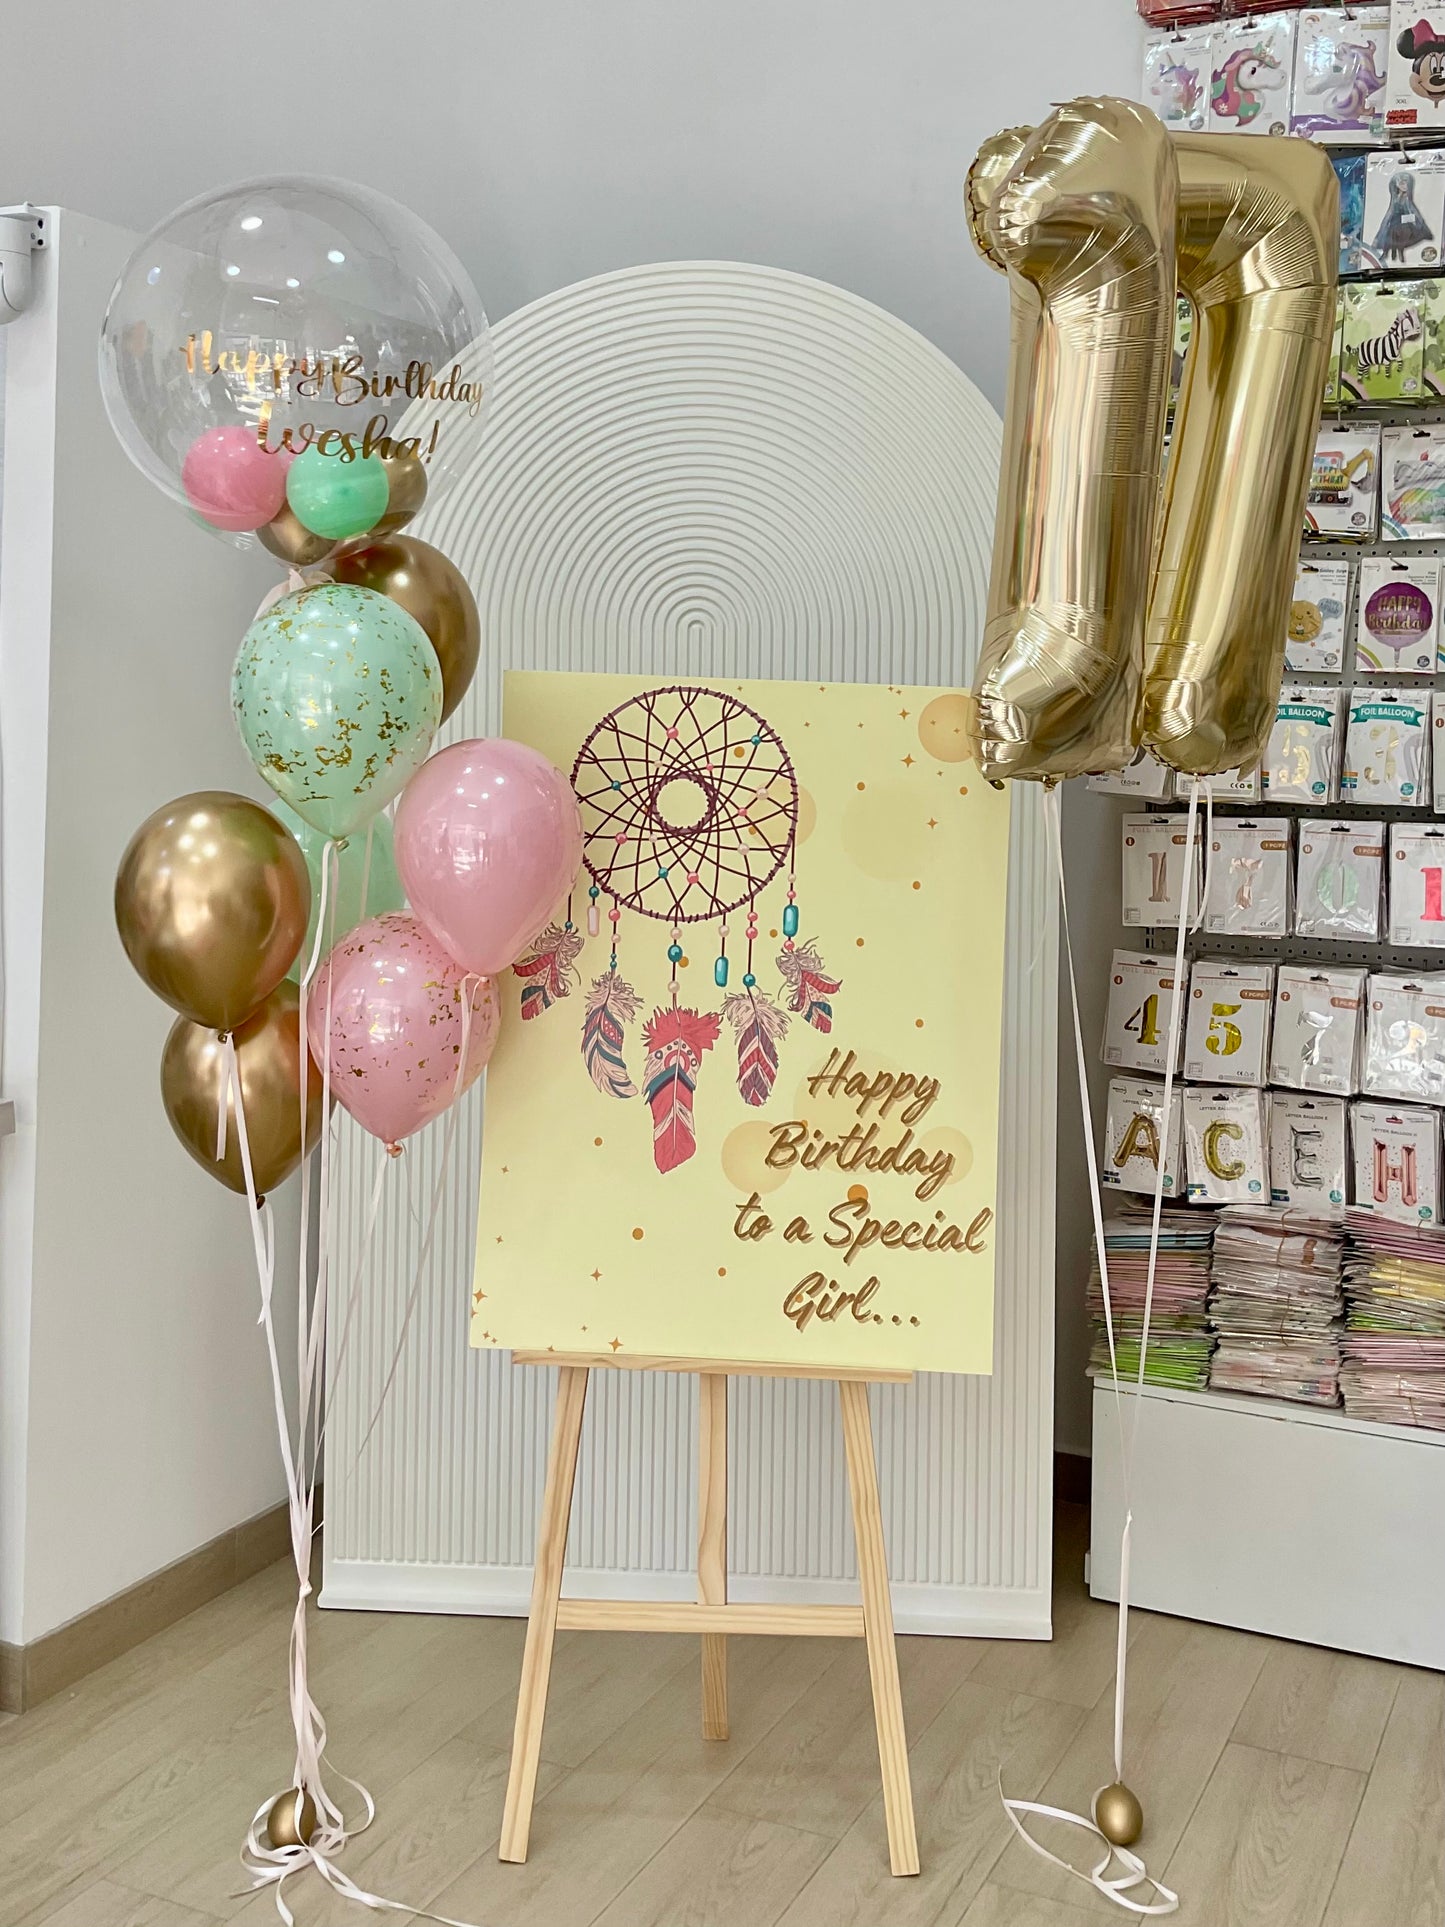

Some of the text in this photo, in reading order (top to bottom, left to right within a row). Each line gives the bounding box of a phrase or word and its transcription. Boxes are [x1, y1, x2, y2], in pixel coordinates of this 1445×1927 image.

[179, 329, 486, 418] Happy Birthday
[1377, 595, 1422, 613] HAPPY
[1276, 707, 1326, 718] OIL BALLOON
[1360, 707, 1416, 718] FOIL BALLOON
[1420, 867, 1445, 921] 1
[1124, 994, 1162, 1046] 4
[1206, 1002, 1242, 1056] 5
[807, 1047, 942, 1126] Happy
[764, 1121, 956, 1201] Birthday
[1113, 1112, 1168, 1172] A
[1203, 1118, 1246, 1181] C
[1289, 1124, 1325, 1191] E
[1373, 1138, 1417, 1206] H
[733, 1191, 994, 1266] to a Special
[782, 1271, 921, 1334] Girl...
